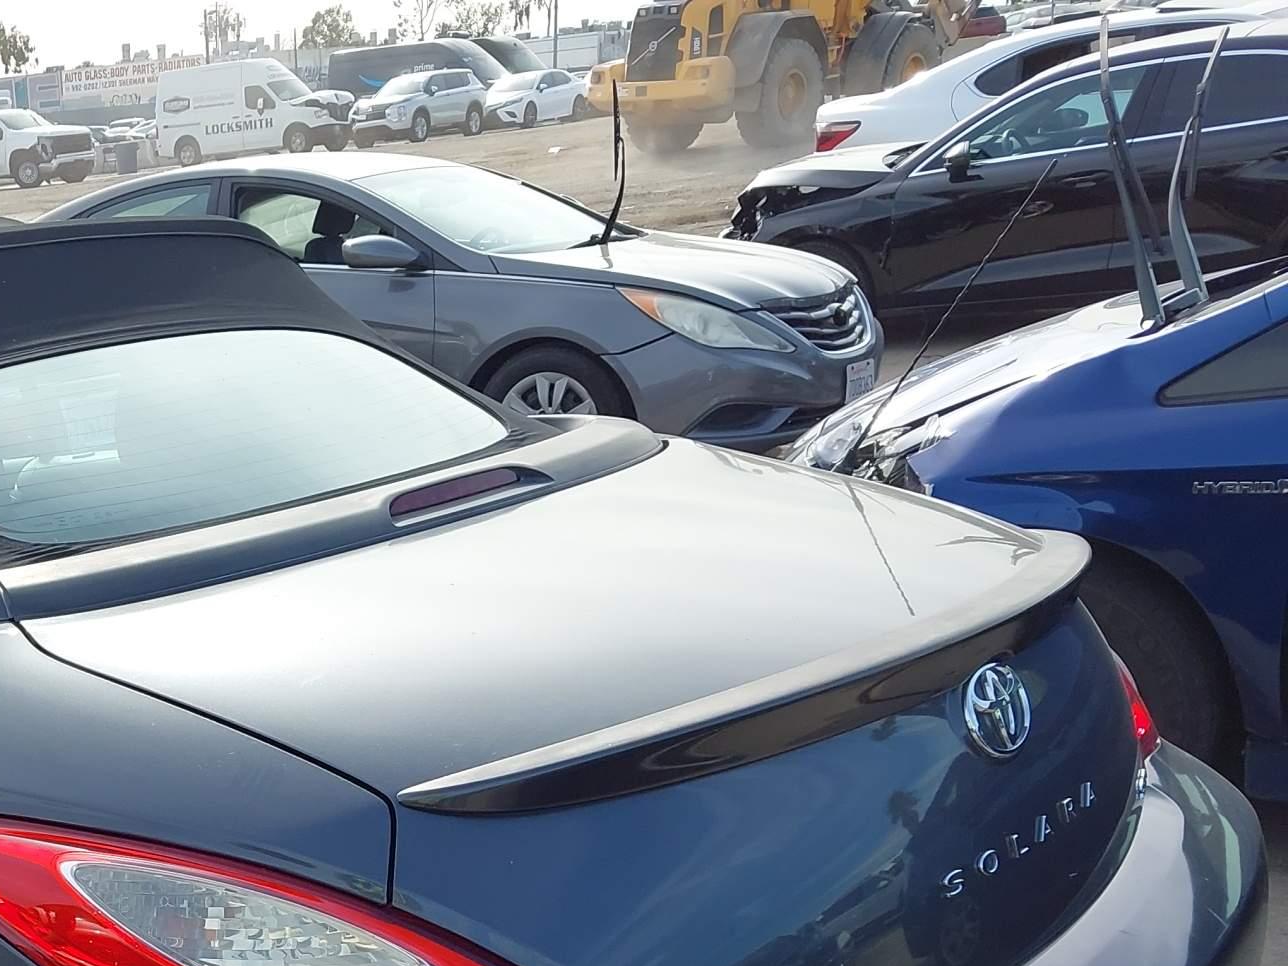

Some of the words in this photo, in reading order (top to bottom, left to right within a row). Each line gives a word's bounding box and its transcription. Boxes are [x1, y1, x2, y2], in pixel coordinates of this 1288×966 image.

[413, 63, 435, 73] prime
[64, 72, 83, 83] AUTO
[205, 117, 273, 136] LOCKSMITH
[1192, 481, 1276, 495] HYBRID
[941, 782, 1096, 898] SOLARA
